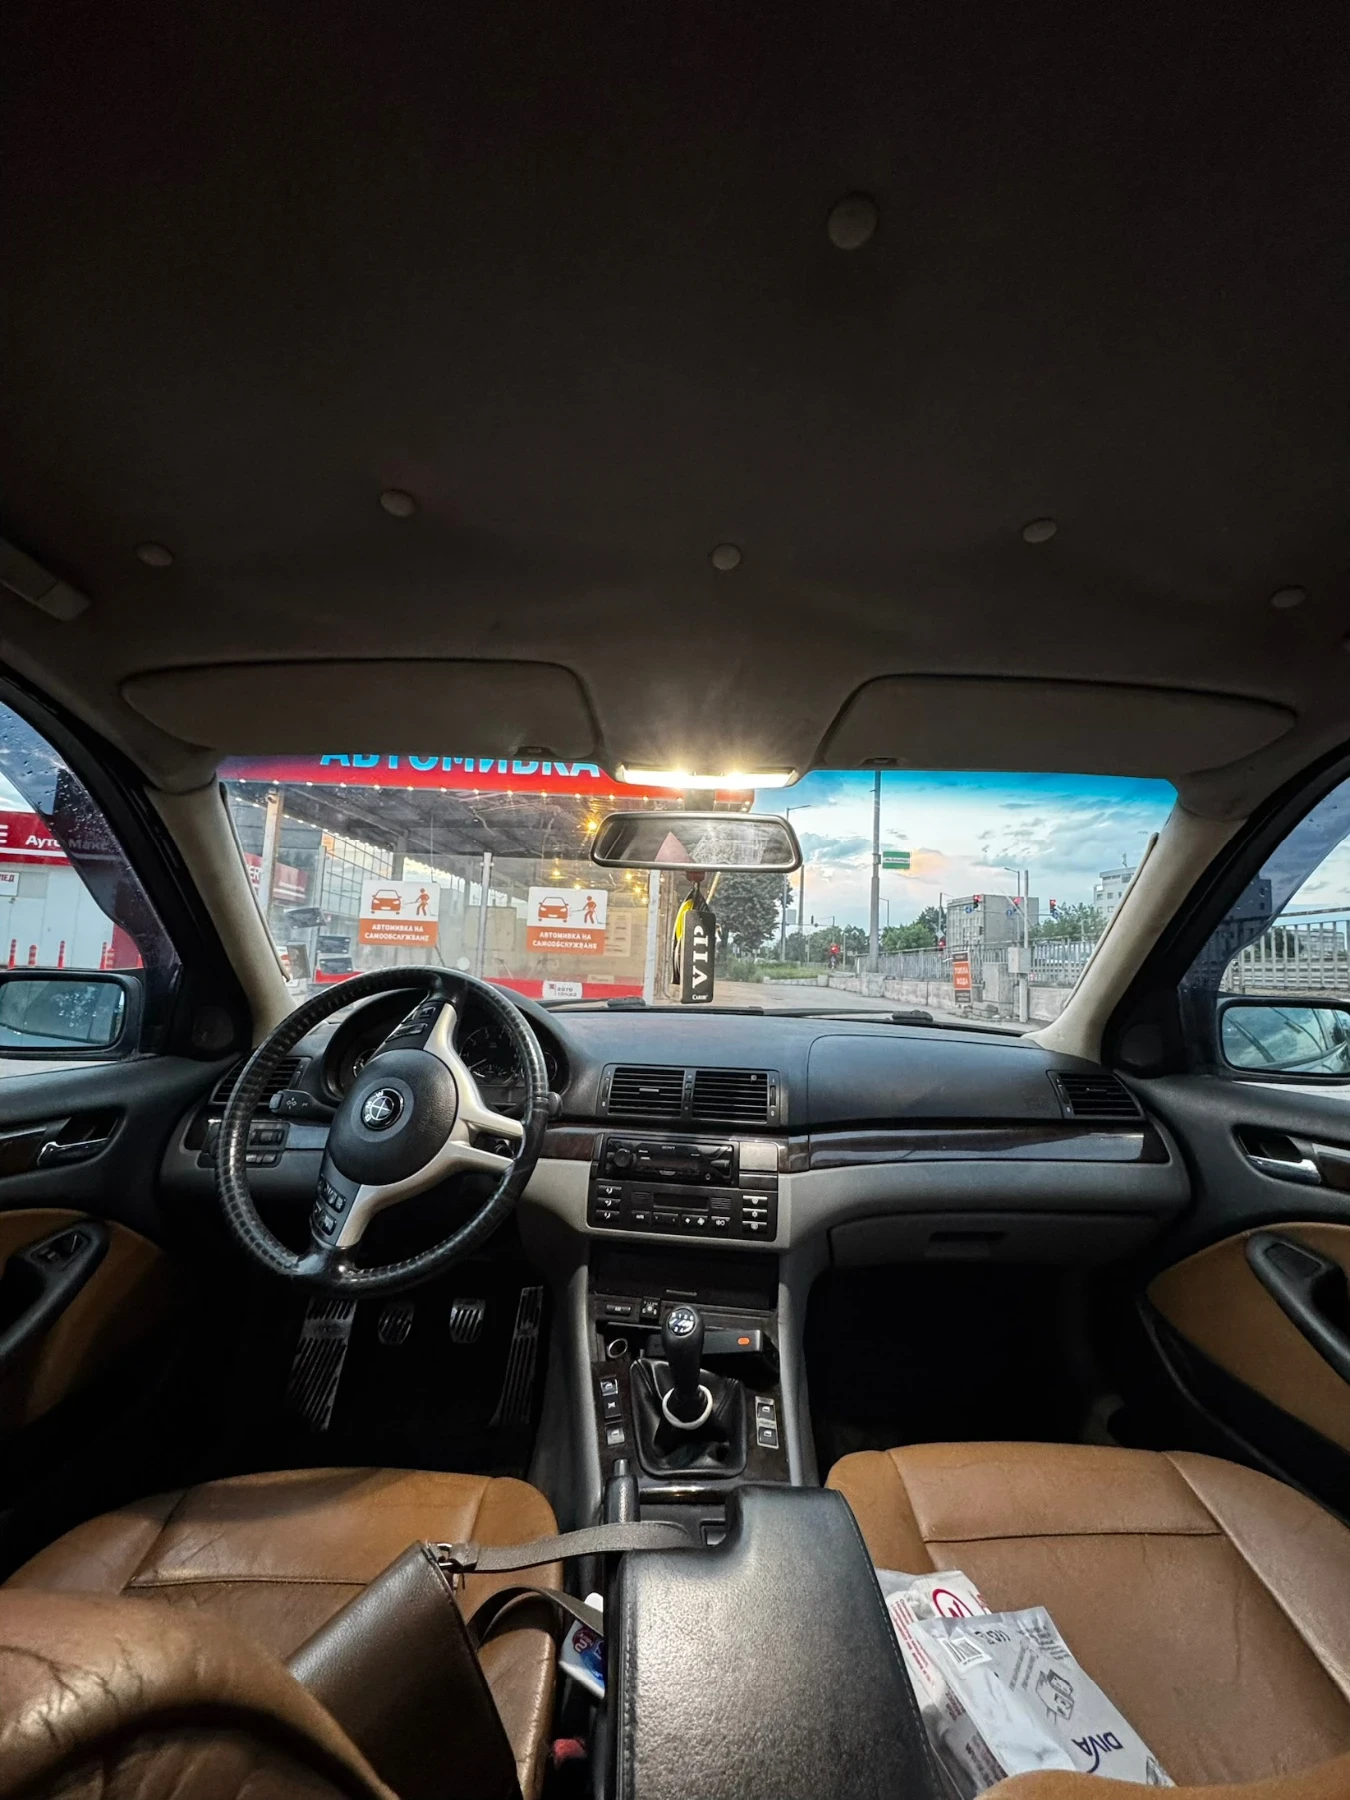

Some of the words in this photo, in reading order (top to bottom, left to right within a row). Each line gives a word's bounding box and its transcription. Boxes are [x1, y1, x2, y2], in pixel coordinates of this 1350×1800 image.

[372, 924, 413, 932] АВТОМИВКА
[539, 932, 581, 940] АВТОМИВКА
[1071, 1731, 1123, 1774] DIVA
